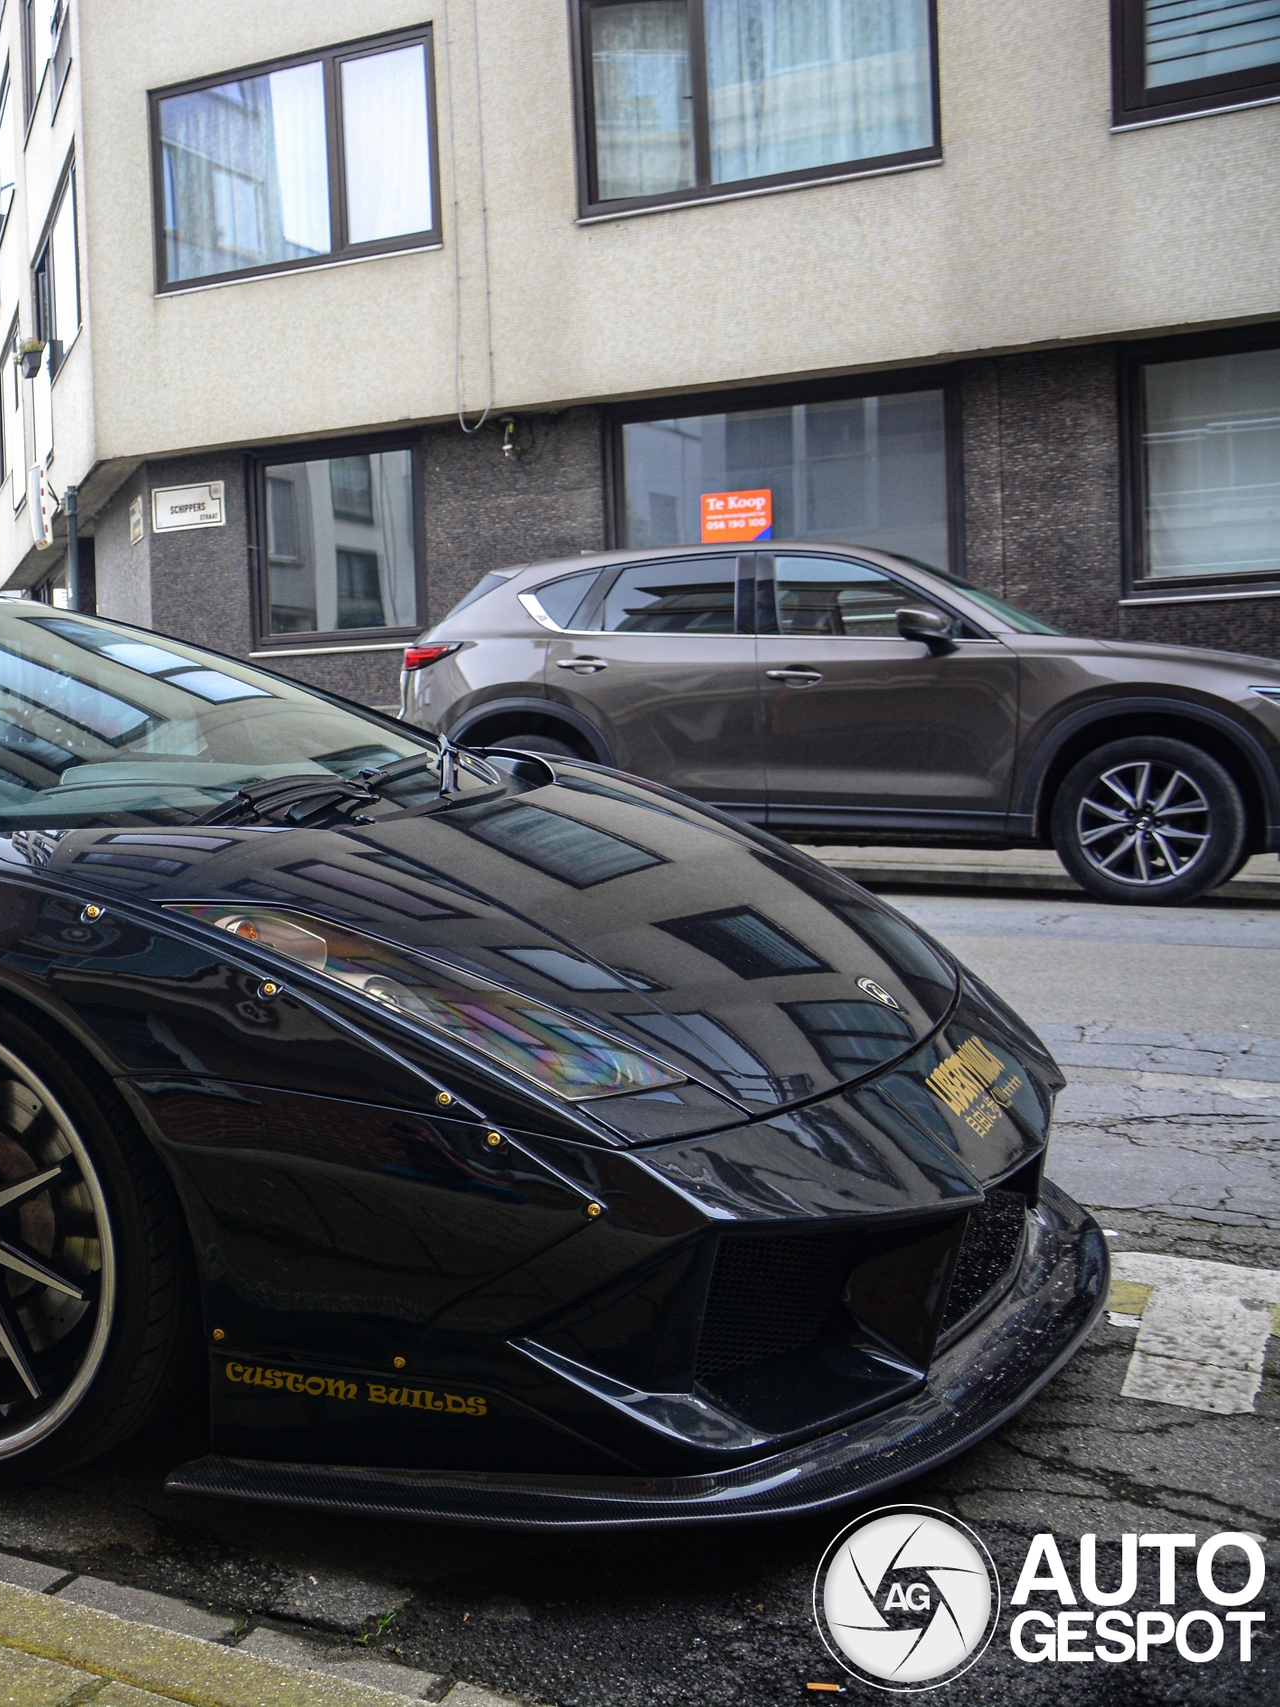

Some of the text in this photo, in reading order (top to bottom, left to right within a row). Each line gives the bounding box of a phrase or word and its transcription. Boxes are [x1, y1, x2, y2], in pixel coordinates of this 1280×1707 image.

[170, 502, 206, 515] SCHIPPERS
[705, 496, 766, 511] Te Koop
[200, 512, 218, 521] STRAAT
[748, 517, 767, 527] 100
[225, 1361, 488, 1416] CUSTOM BUILDS
